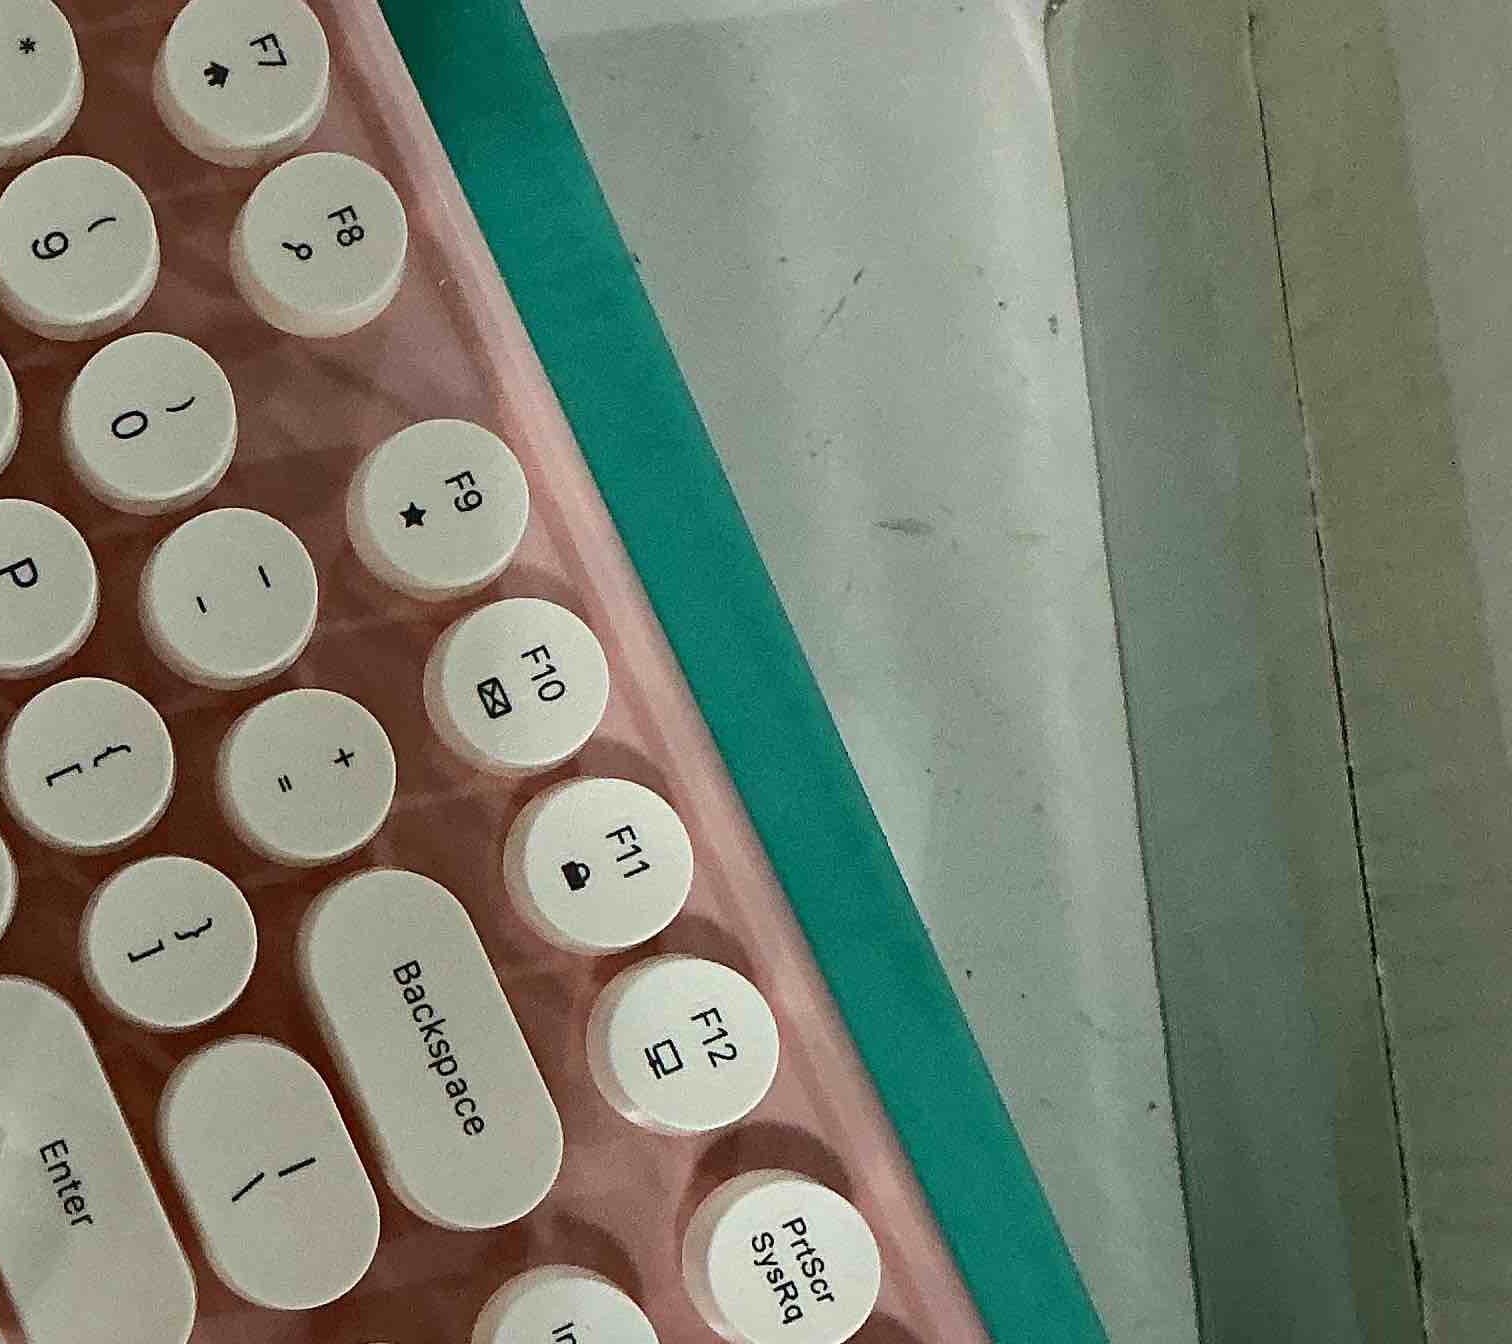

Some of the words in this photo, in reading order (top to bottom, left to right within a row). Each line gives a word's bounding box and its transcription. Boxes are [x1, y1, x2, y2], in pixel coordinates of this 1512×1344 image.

[250, 33, 287, 66] F7
[88, 217, 116, 232] (
[328, 205, 364, 247] F8
[32, 232, 68, 259] 9
[166, 397, 195, 412] )
[111, 410, 148, 439] 0
[445, 471, 482, 512] F9
[521, 645, 566, 701] F10
[47, 763, 82, 786] [
[334, 748, 354, 768] +
[278, 775, 292, 792] =
[606, 825, 650, 878] F11
[128, 939, 165, 963] ]
[393, 960, 484, 1135] Backspace
[691, 1008, 737, 1067] F12
[40, 1139, 93, 1225] Enter
[752, 1232, 803, 1324] SysRq
[782, 1217, 834, 1302] PrtScr
